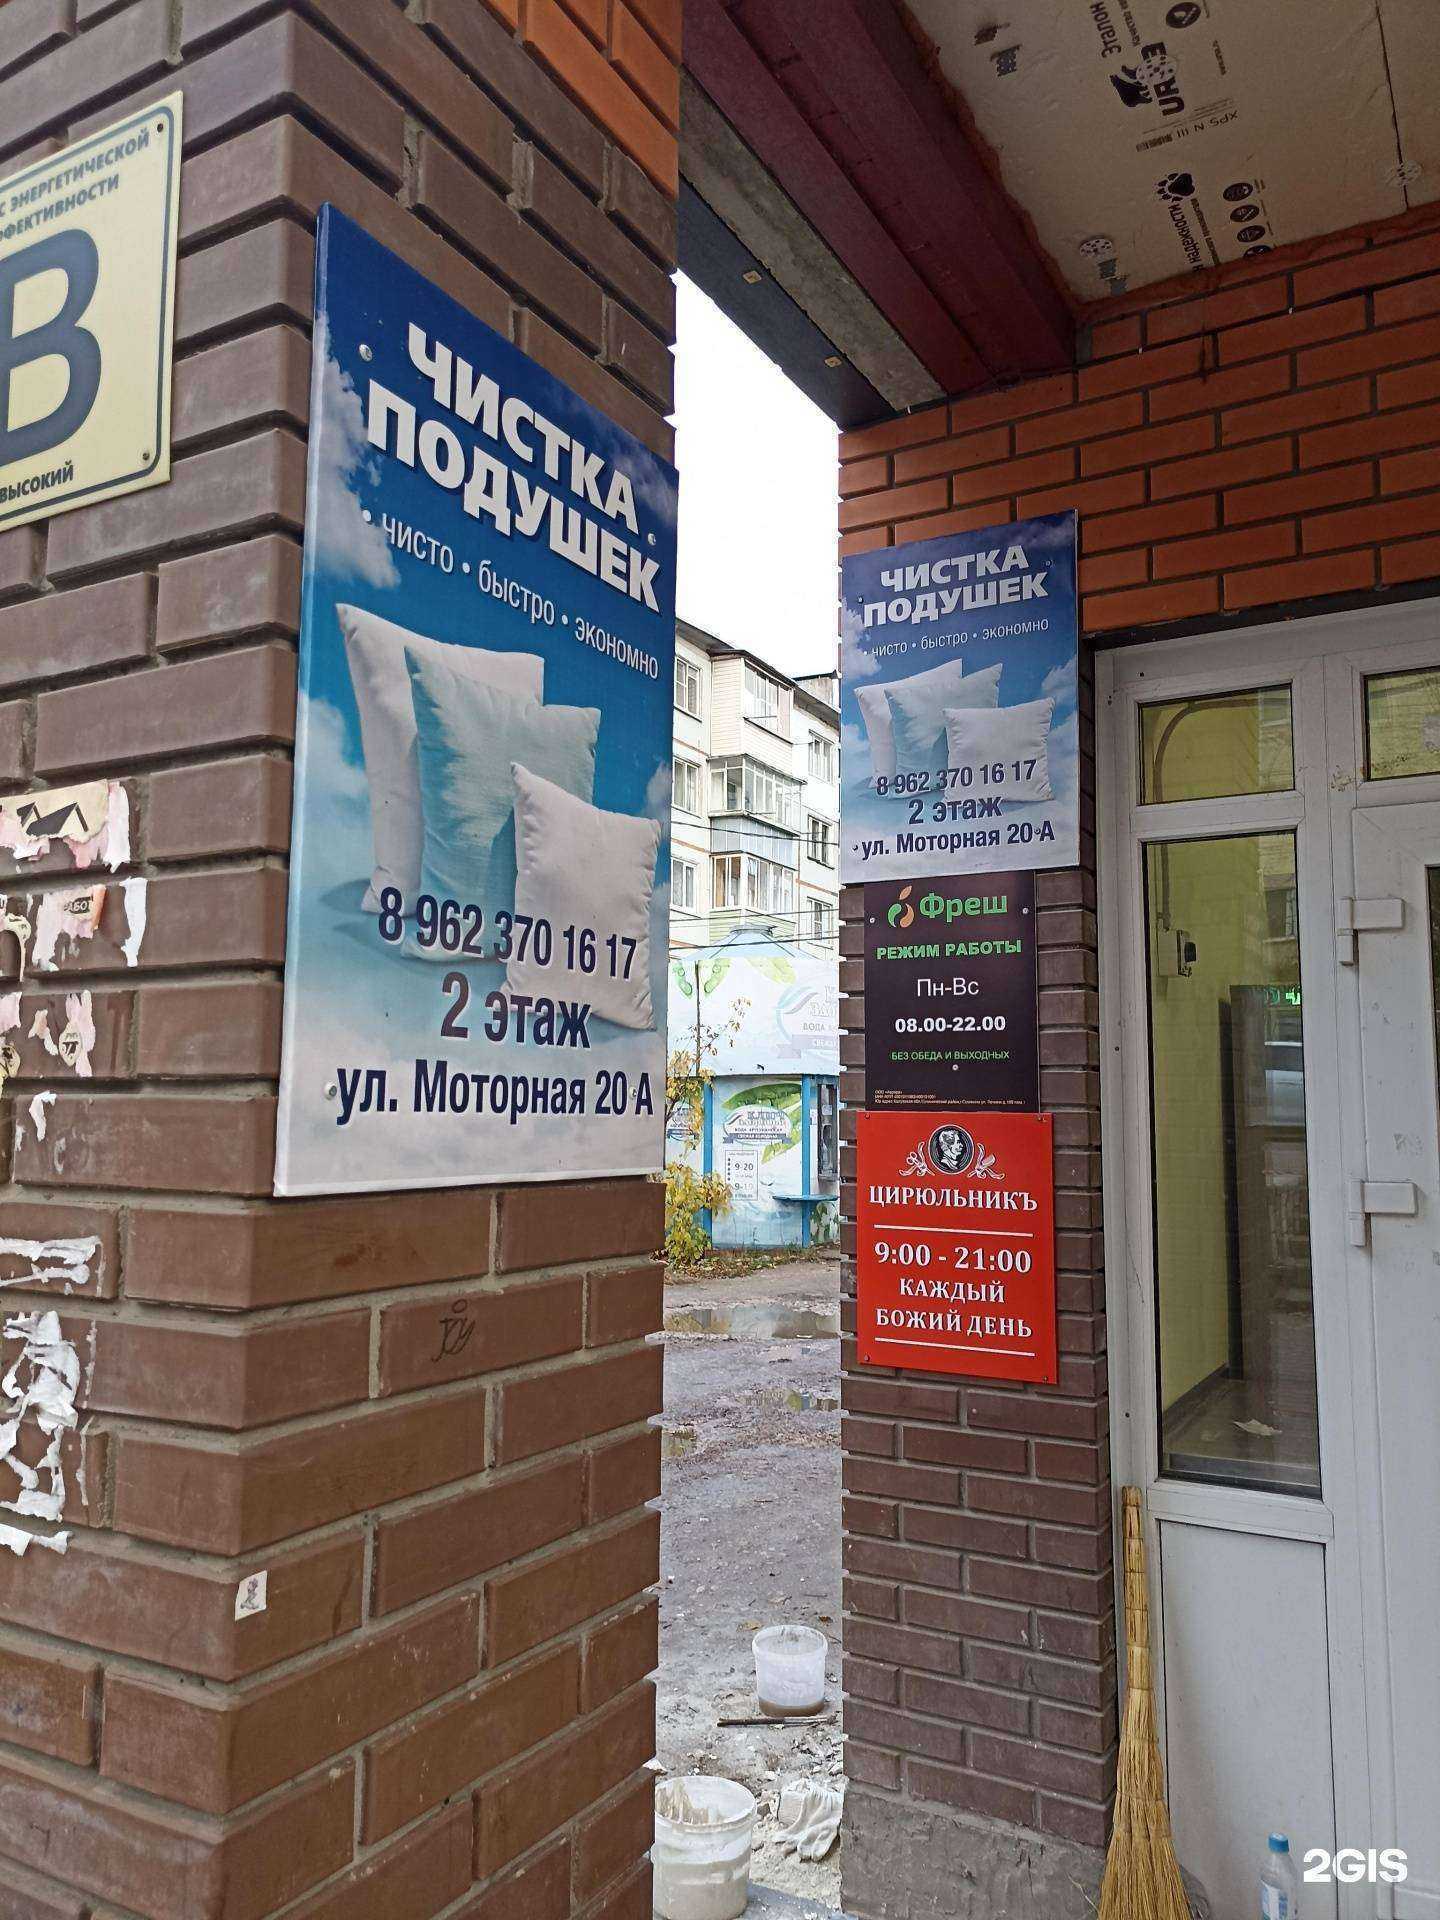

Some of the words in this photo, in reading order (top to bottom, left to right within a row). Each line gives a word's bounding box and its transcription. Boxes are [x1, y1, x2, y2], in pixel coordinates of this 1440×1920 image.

[10, 128, 150, 212] ЭНЕРГЕТИЧЕСКОЙ
[408, 322, 639, 535] ЧИСТКА
[367, 379, 660, 613] ПОДУШЕК
[880, 544, 1030, 593] ЧИСТКА
[382, 513, 454, 574] чисто
[478, 560, 555, 627] быстро
[574, 616, 659, 680] экономно
[863, 572, 1048, 628] ПОДУШЕК
[872, 640, 908, 658] чисто
[920, 630, 968, 652] быстро
[982, 618, 1049, 640] экономно
[876, 775, 889, 796] 8
[894, 771, 930, 795] 962
[936, 766, 973, 792] 370
[979, 763, 1005, 785] 16
[1012, 759, 1037, 782] 17
[908, 798, 925, 825] 2
[932, 794, 1003, 822] этаж
[861, 836, 890, 860] ул.
[896, 828, 1000, 855] Моторная
[1007, 822, 1033, 844] 20
[1038, 820, 1055, 842] А
[919, 892, 1008, 923] Фреш
[378, 886, 404, 942] 8
[416, 893, 484, 955] 962
[493, 910, 553, 967] 370
[563, 925, 597, 974] 16
[606, 934, 637, 980] 17
[876, 944, 940, 960] РЕЖИМ
[945, 939, 1022, 956] РАБОТЫ
[917, 978, 980, 997] Пн-Вс
[440, 971, 470, 1039] 2
[484, 990, 592, 1049] этаж
[894, 1016, 1006, 1033] 08.00-22.00
[891, 1051, 909, 1061] БЕЗ
[911, 1050, 943, 1061] ОБЕДА
[945, 1051, 953, 1060] И
[954, 1050, 1010, 1061] ВЫХОДНЫХ
[336, 1067, 398, 1125] ул.
[413, 1058, 585, 1125] Моторная
[595, 1070, 627, 1115] 20
[635, 1073, 654, 1116] А
[869, 1185, 1038, 1212] ЦИРЮЛЬНИКЪ
[874, 1242, 931, 1267] 9:00
[954, 1247, 1032, 1273] 21:00
[899, 1277, 1005, 1303] КАЖДЫЙ
[876, 1307, 963, 1332] БОЖИЙ
[967, 1316, 1033, 1338] ДЕНЬ
